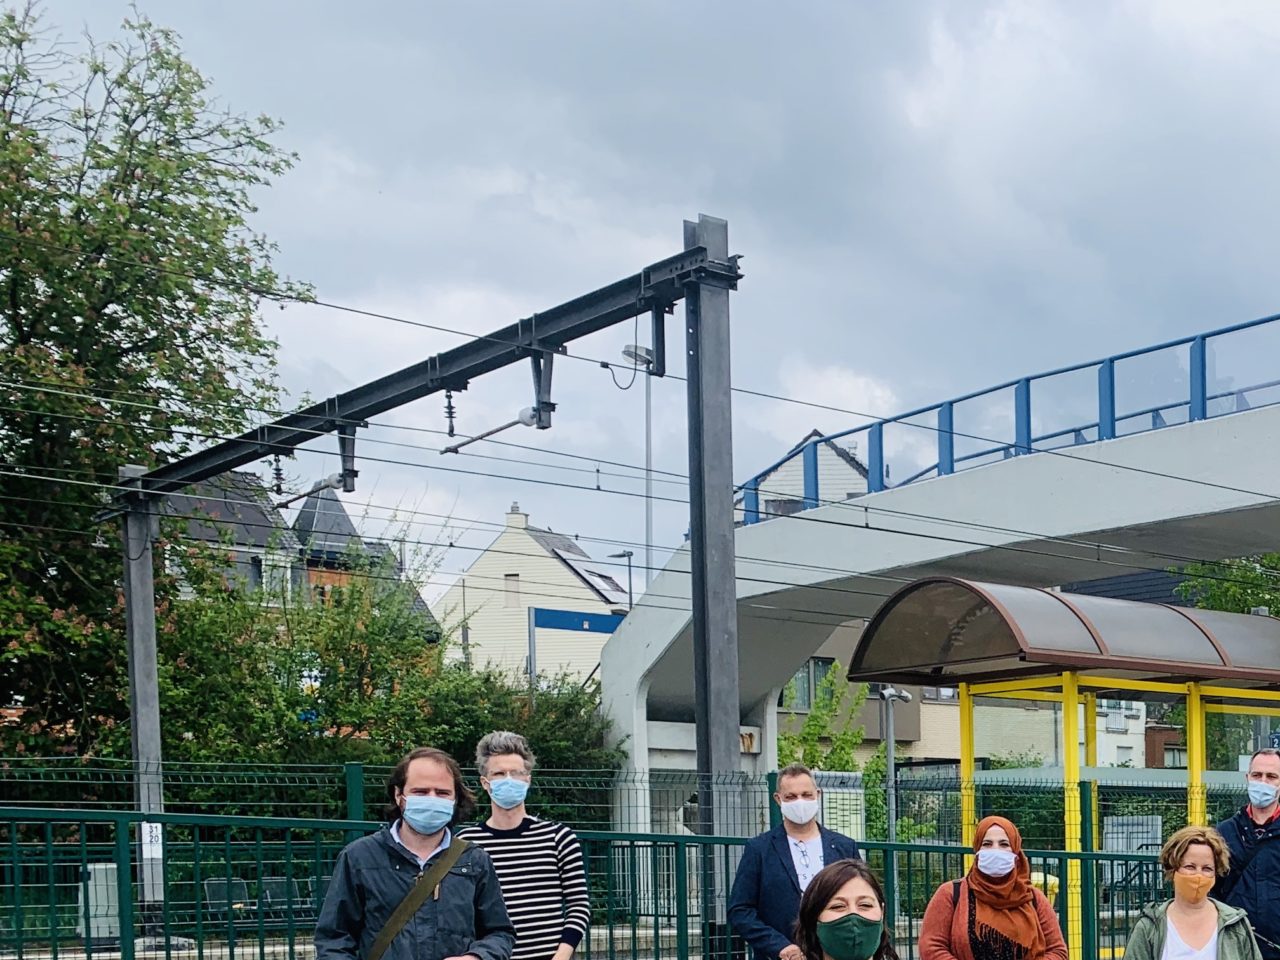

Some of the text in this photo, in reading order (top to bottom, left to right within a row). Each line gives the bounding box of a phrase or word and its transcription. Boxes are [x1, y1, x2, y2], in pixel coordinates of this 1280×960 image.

[1273, 738, 1279, 748] 2
[149, 825, 158, 834] 31
[149, 834, 160, 843] 20
